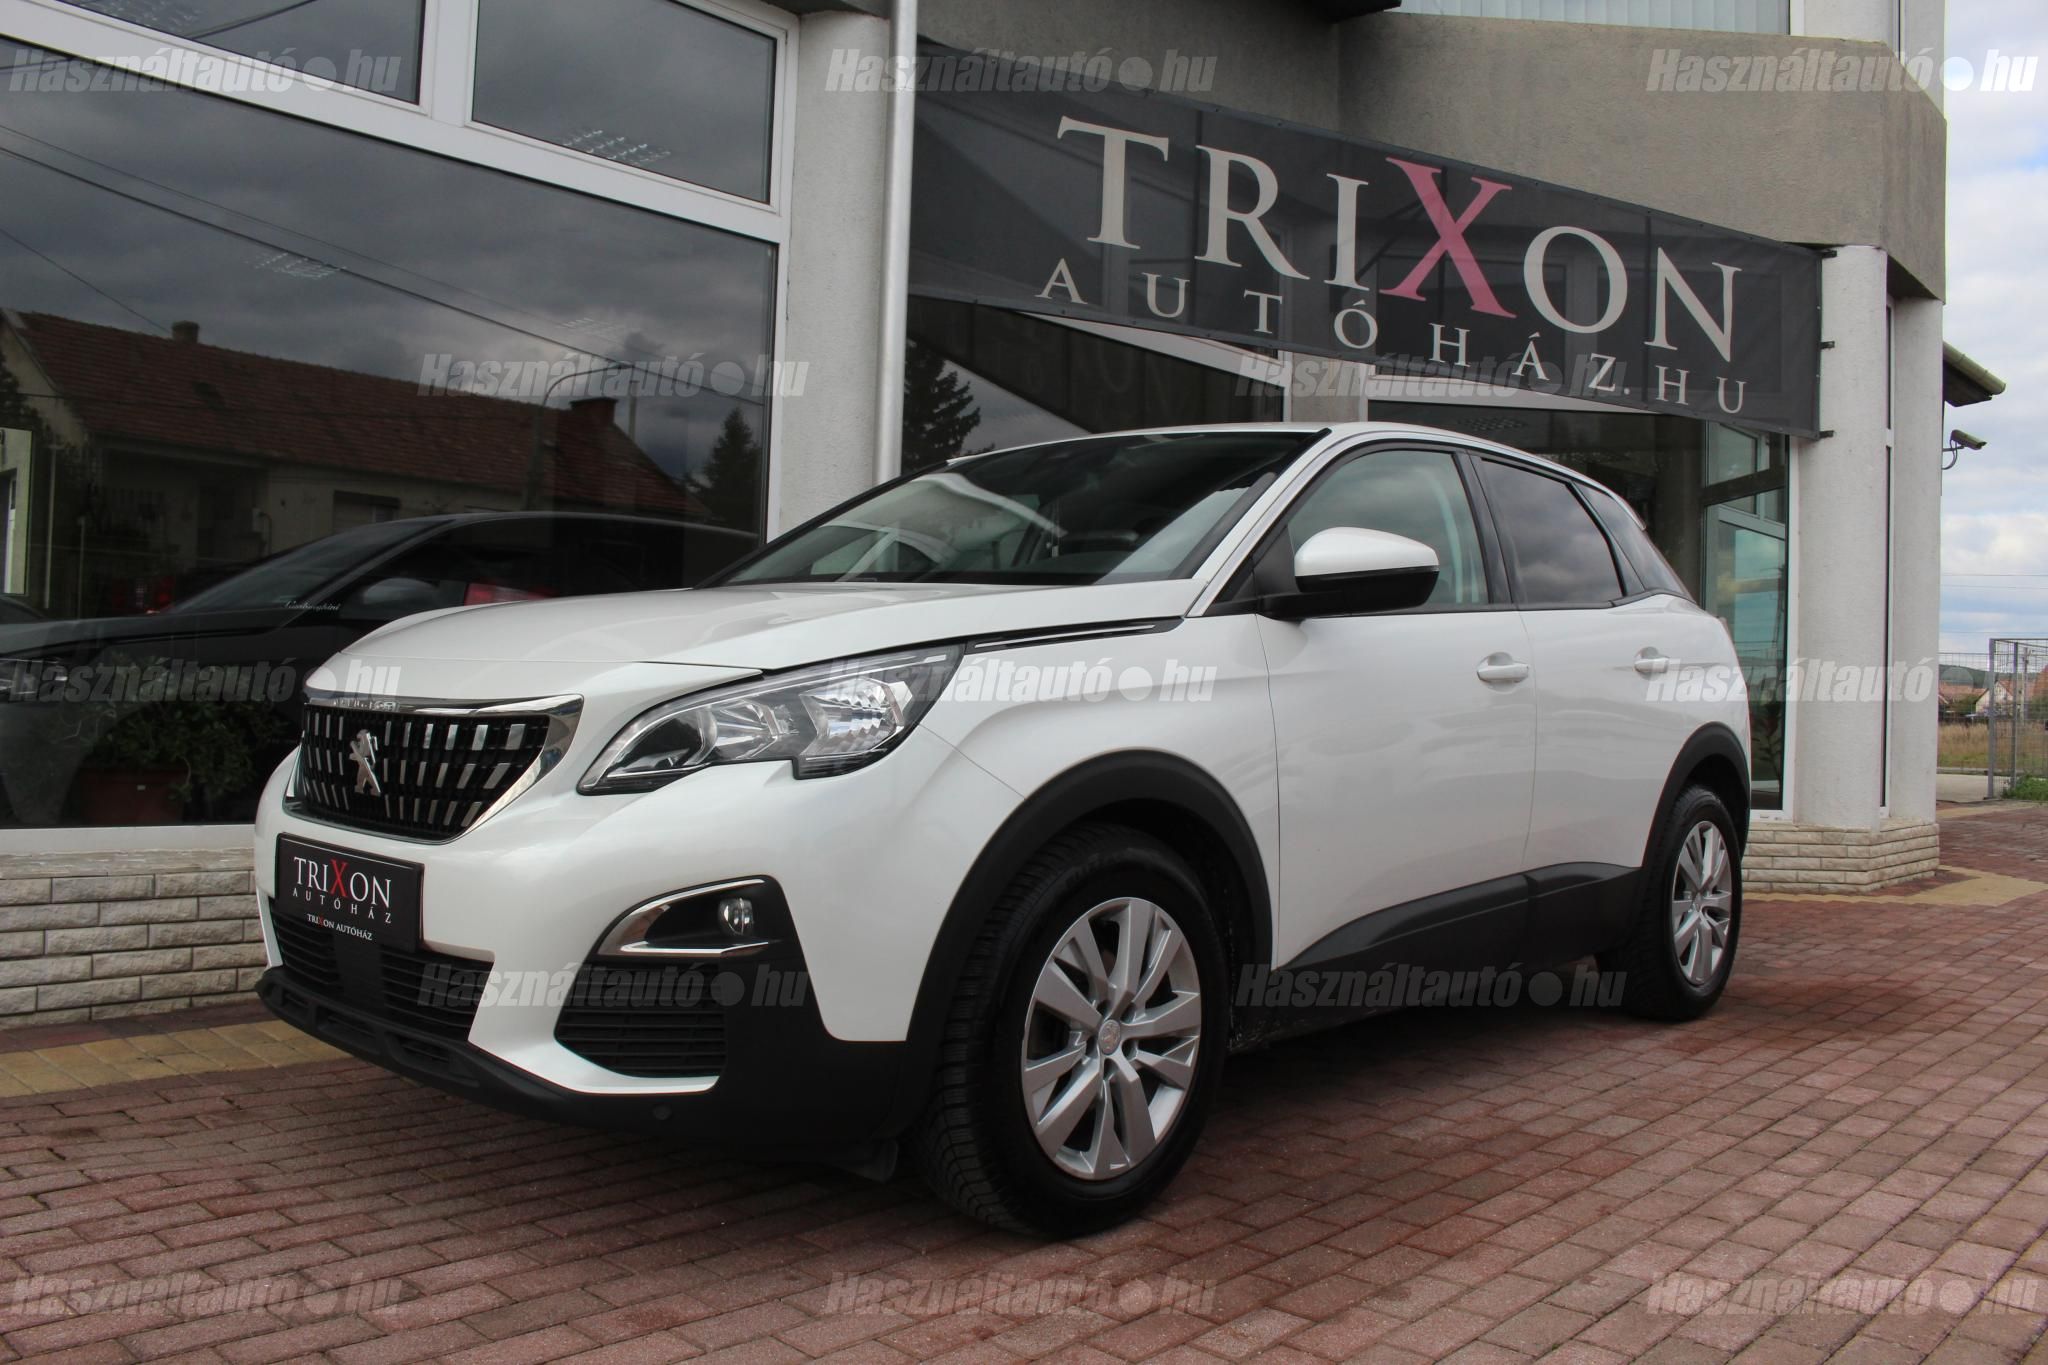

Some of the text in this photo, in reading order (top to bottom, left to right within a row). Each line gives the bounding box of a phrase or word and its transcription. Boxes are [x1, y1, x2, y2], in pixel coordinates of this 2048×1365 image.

[1056, 114, 1742, 363] TRIXON
[293, 856, 392, 909] TRIXON
[292, 887, 392, 924] AUTÓHÁZ
[306, 913, 373, 941] TRIXON AUTÓHÁZ
